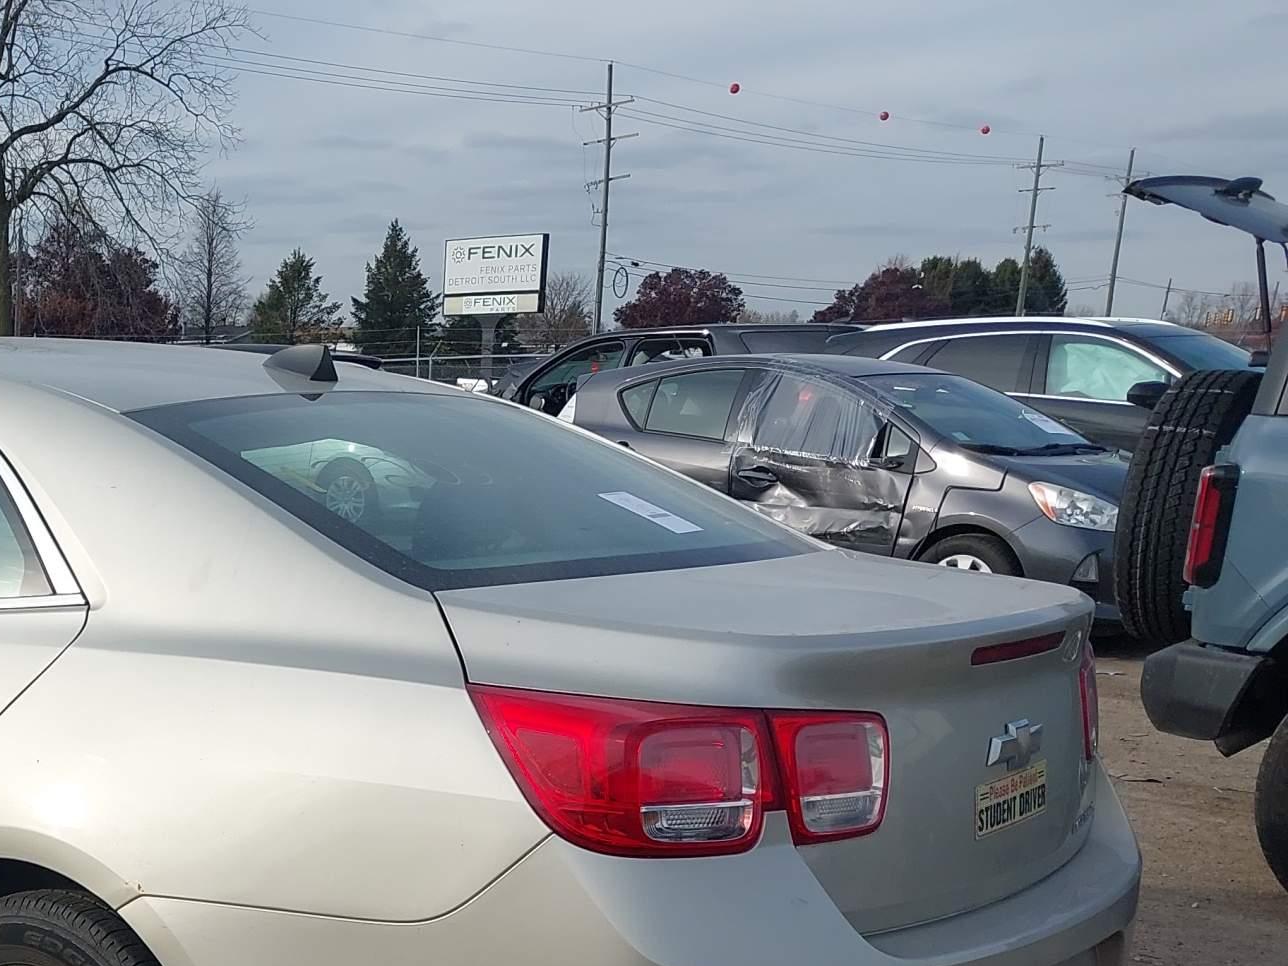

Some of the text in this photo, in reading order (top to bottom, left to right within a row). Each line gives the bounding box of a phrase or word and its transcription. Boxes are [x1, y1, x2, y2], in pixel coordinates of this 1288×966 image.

[467, 243, 535, 260] FENIX
[480, 264, 537, 274] FENIX PARTS
[448, 273, 537, 286] DETROIT SOUTH LLC
[473, 296, 516, 306] FENIX
[989, 783, 1010, 801] Please
[1010, 777, 1019, 793] Be
[978, 783, 1046, 832] STUDENT DRIVER
